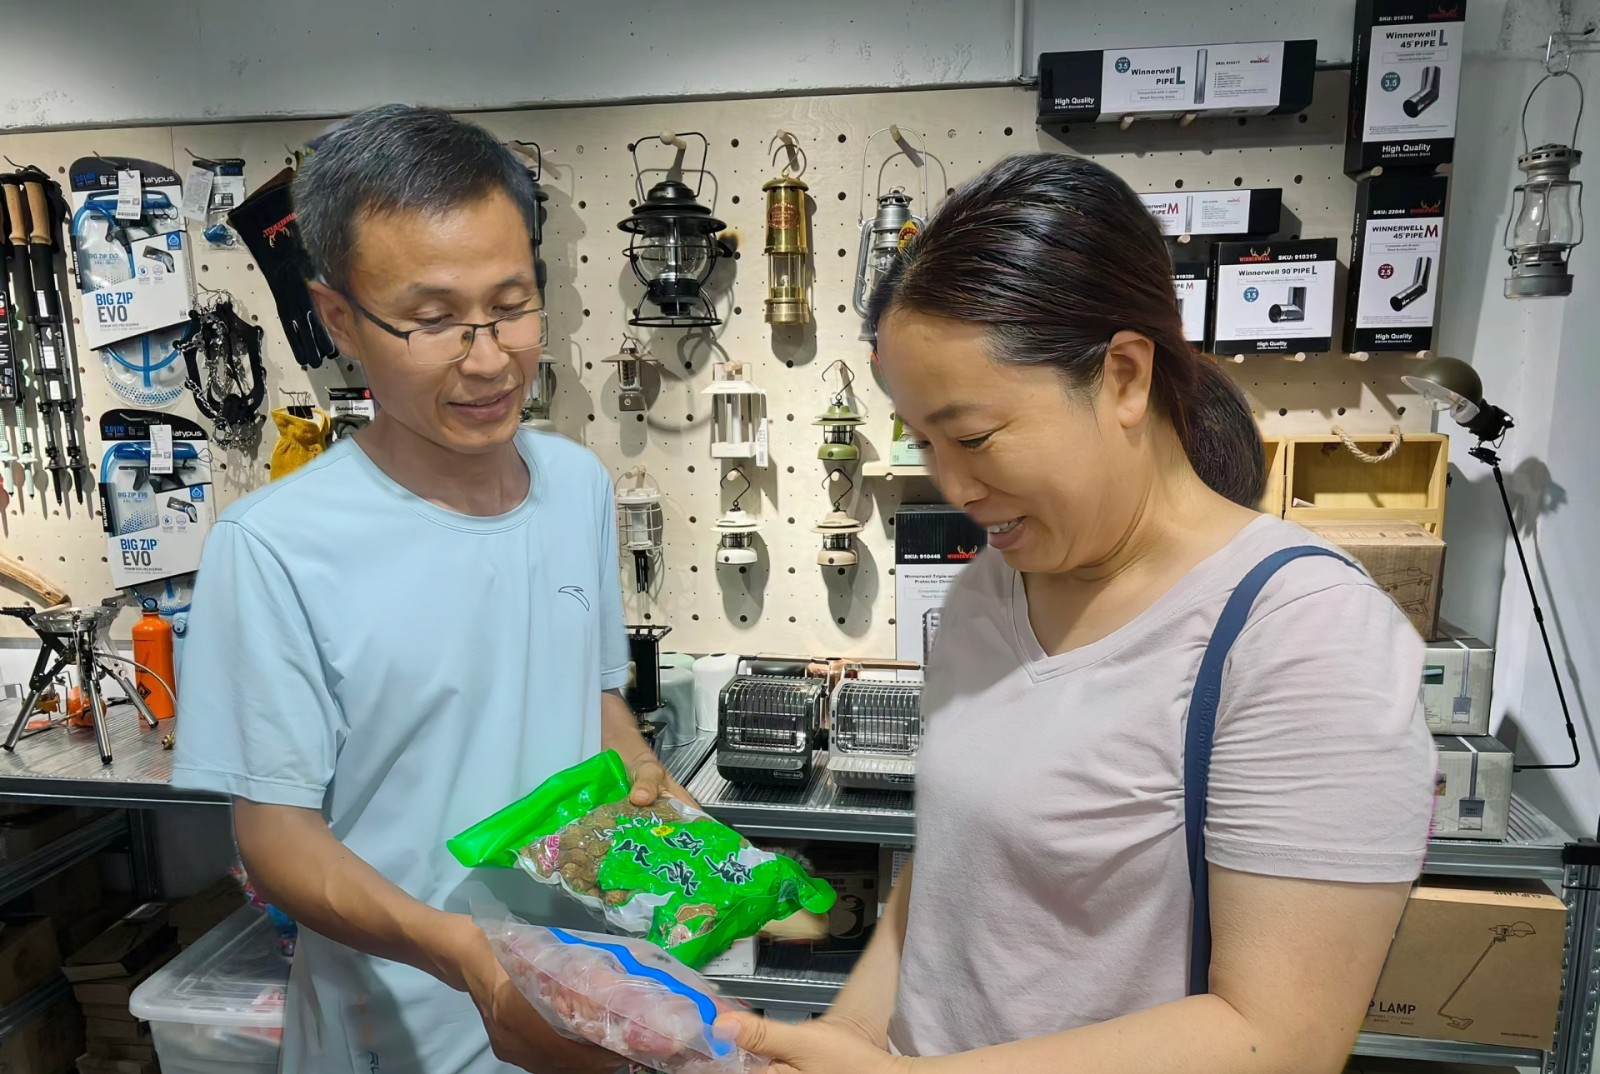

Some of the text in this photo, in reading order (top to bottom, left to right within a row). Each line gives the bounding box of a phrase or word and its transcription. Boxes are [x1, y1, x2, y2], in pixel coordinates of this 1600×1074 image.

[1386, 30, 1437, 39] Winnerwell
[1439, 29, 1448, 46] L
[1131, 67, 1175, 75] Winnerwell
[1176, 66, 1185, 85] L
[1384, 79, 1397, 87] 3.5
[1382, 143, 1431, 153] High Quality
[1167, 203, 1179, 214] M
[1424, 224, 1439, 238] M
[1311, 265, 1318, 275] L
[1185, 282, 1194, 290] M
[95, 291, 133, 305] BIG ZIP
[97, 305, 128, 323] EVO
[120, 538, 158, 550] BIG ZIP
[122, 550, 152, 566] EVO
[1379, 1001, 1416, 1014] LAMP
